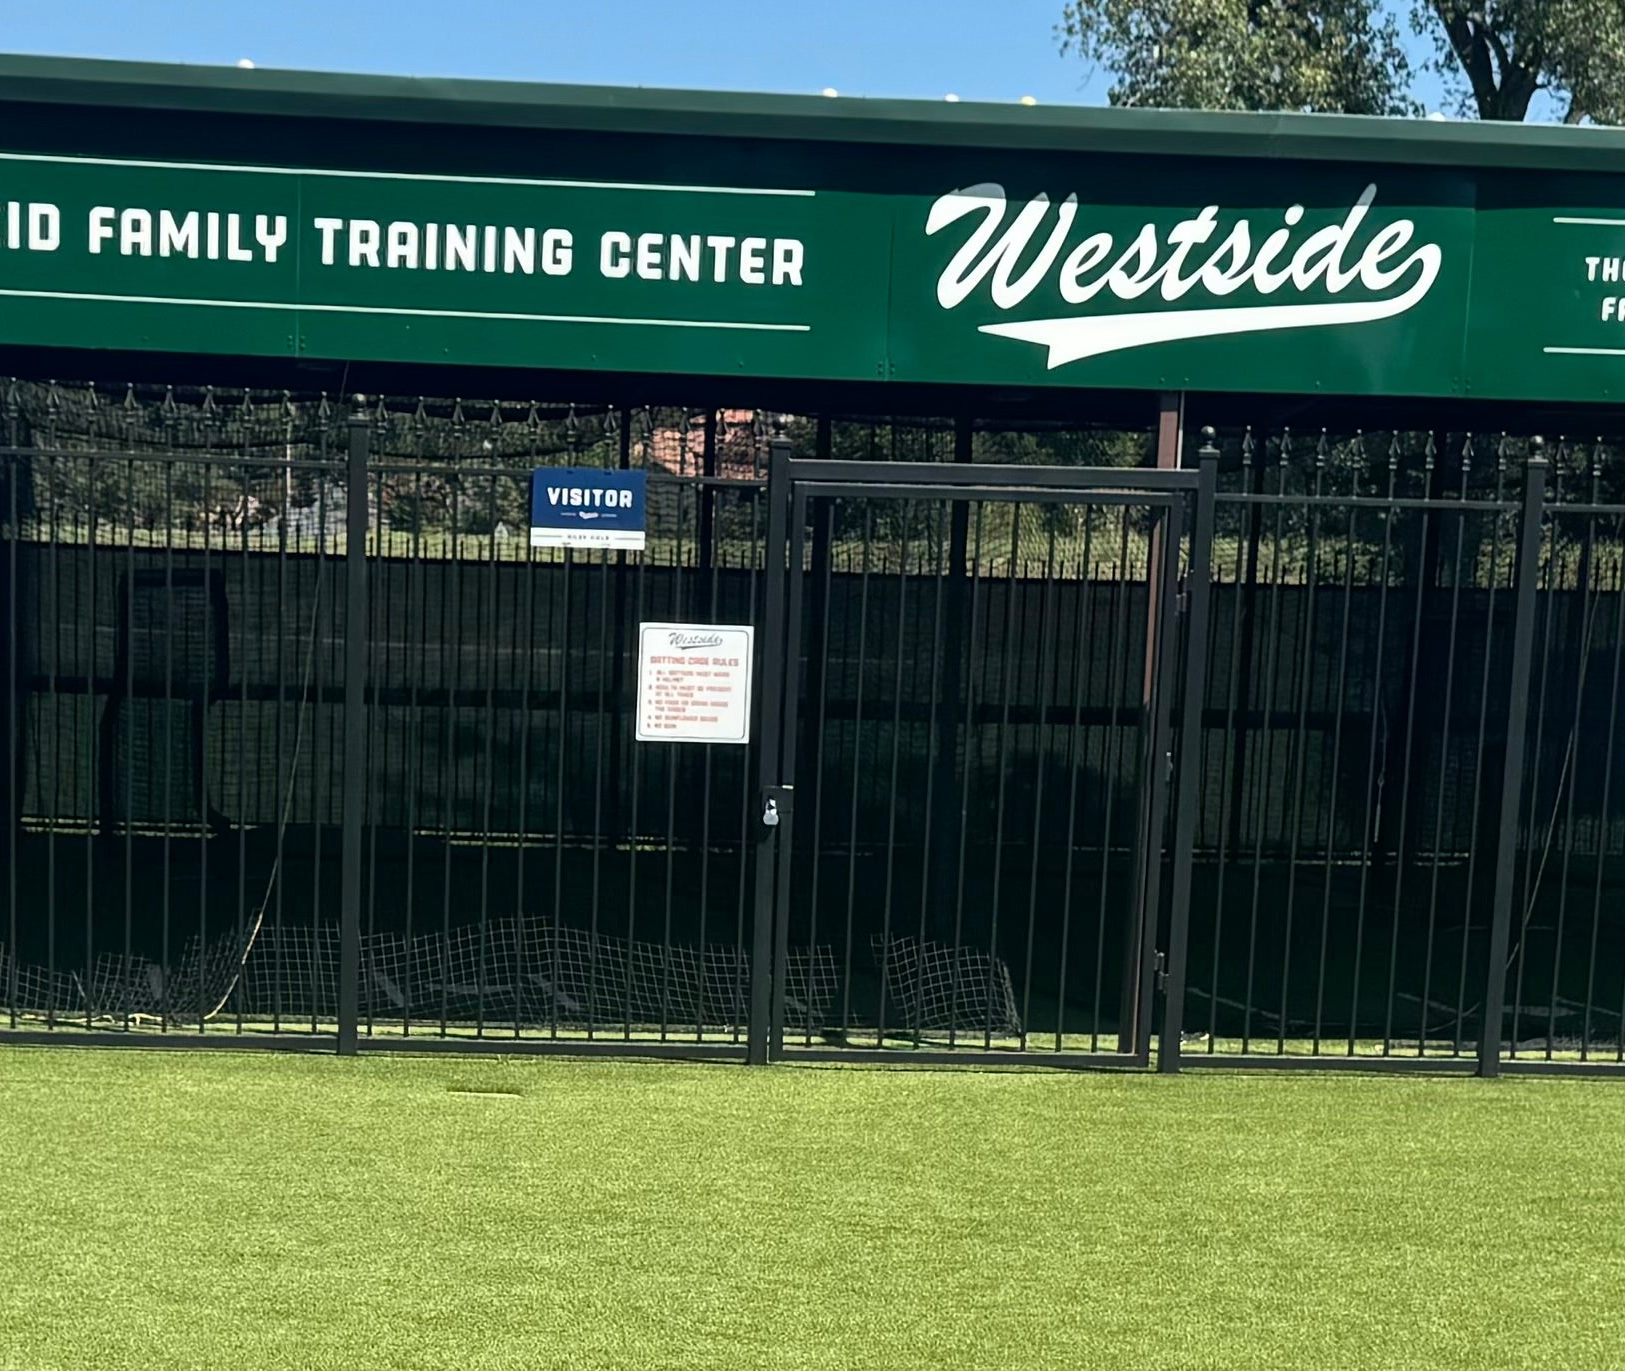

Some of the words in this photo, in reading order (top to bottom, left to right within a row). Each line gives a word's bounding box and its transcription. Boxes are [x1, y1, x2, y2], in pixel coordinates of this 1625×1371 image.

[88, 206, 287, 263] FAMILY
[314, 217, 573, 276] TRAINING
[600, 231, 804, 286] CENTER
[926, 183, 1442, 370] Westside
[547, 487, 633, 508] VISITOR
[668, 632, 724, 651] Westside
